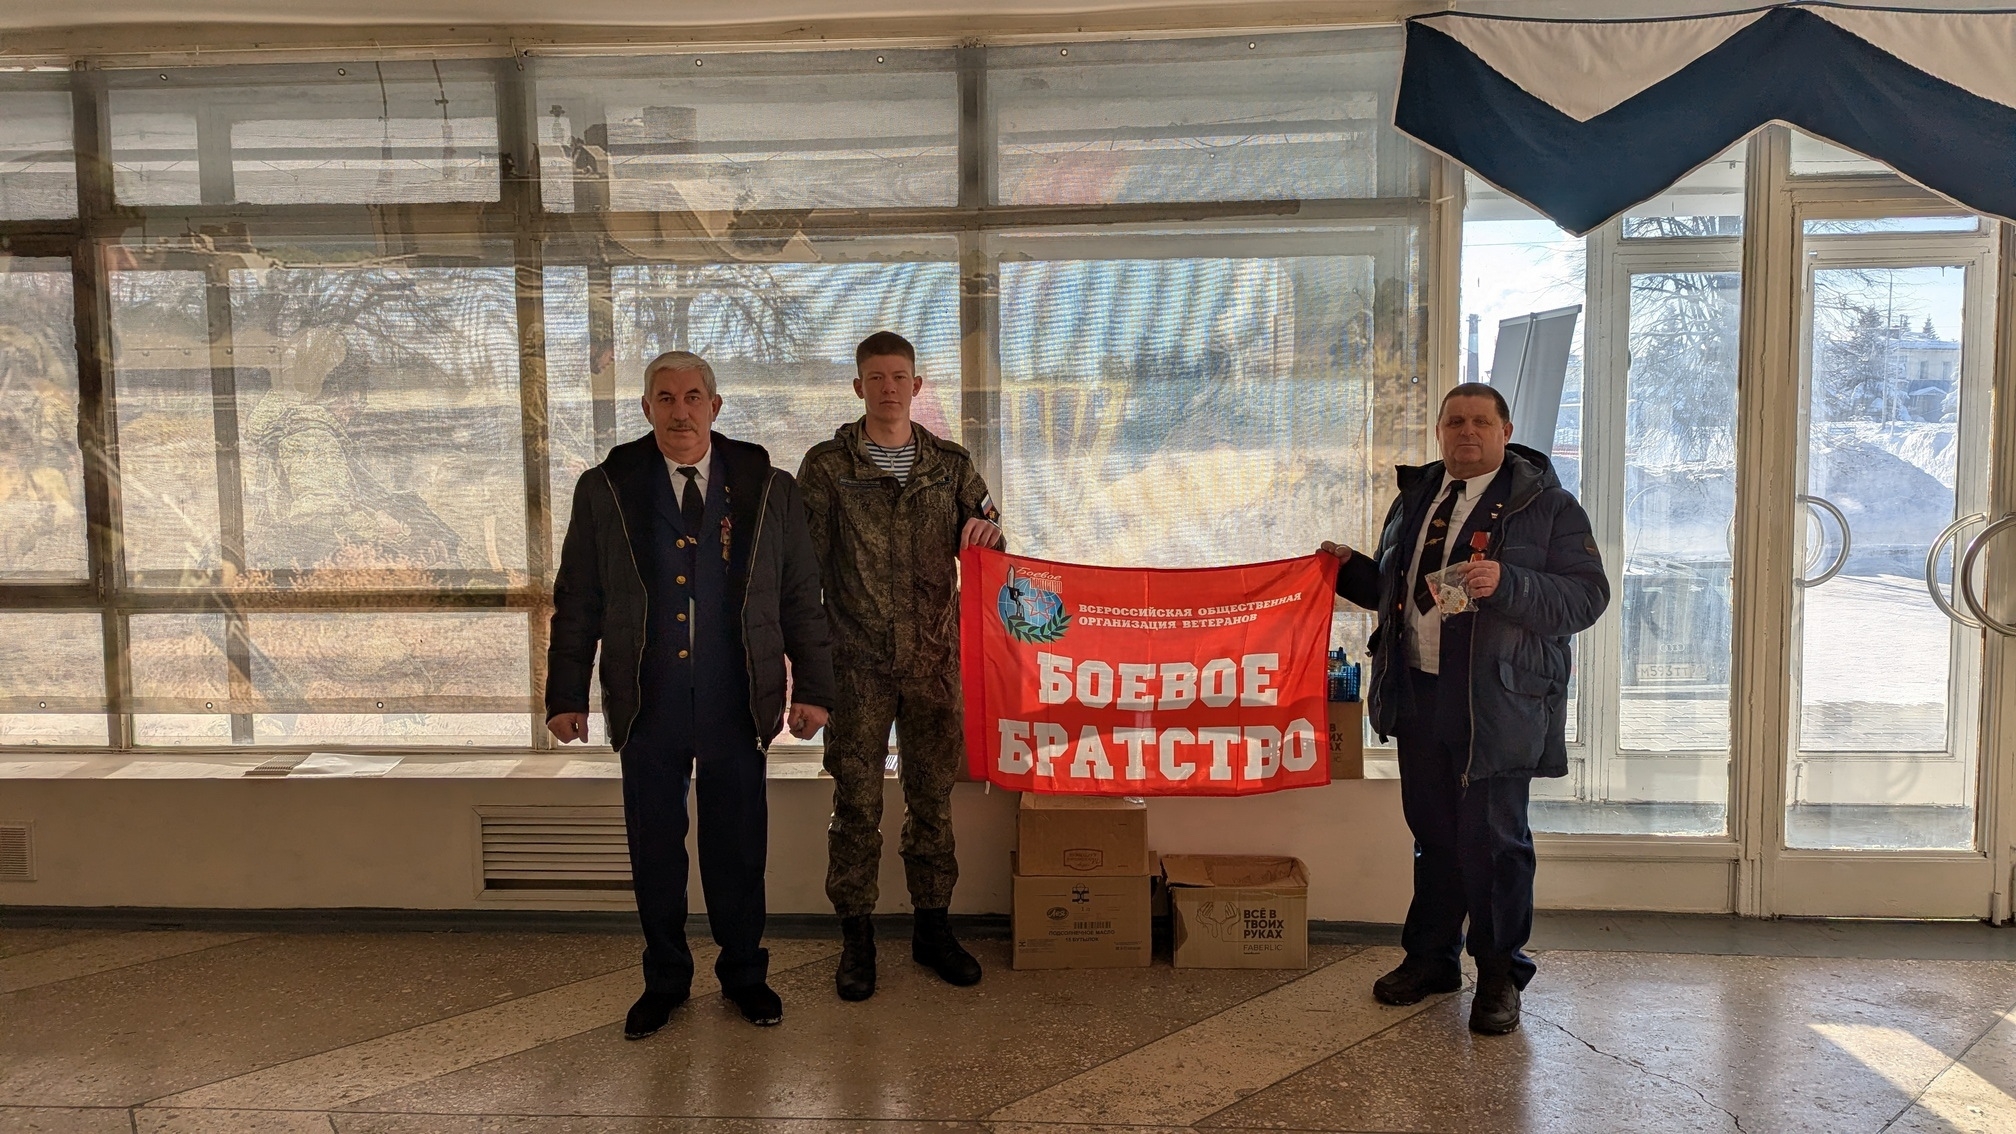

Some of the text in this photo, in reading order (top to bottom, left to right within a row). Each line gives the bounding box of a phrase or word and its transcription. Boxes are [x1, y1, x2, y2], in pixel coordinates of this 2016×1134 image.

[1016, 567, 1061, 580] Боевое
[1078, 592, 1302, 618] ВСЕРОССИЙСКАЯ ОБЩЕСТВЕННАЯ
[1078, 613, 1258, 630] ОРГАНИЗАЦИЯ ВЕТЕРАНОВ
[1037, 651, 1279, 712] БОЕВОЕ
[997, 717, 1318, 781] БРАТСТВО
[1269, 910, 1276, 919] В
[1243, 920, 1284, 929] ТВОИХ
[1243, 930, 1282, 939] РУКАХ
